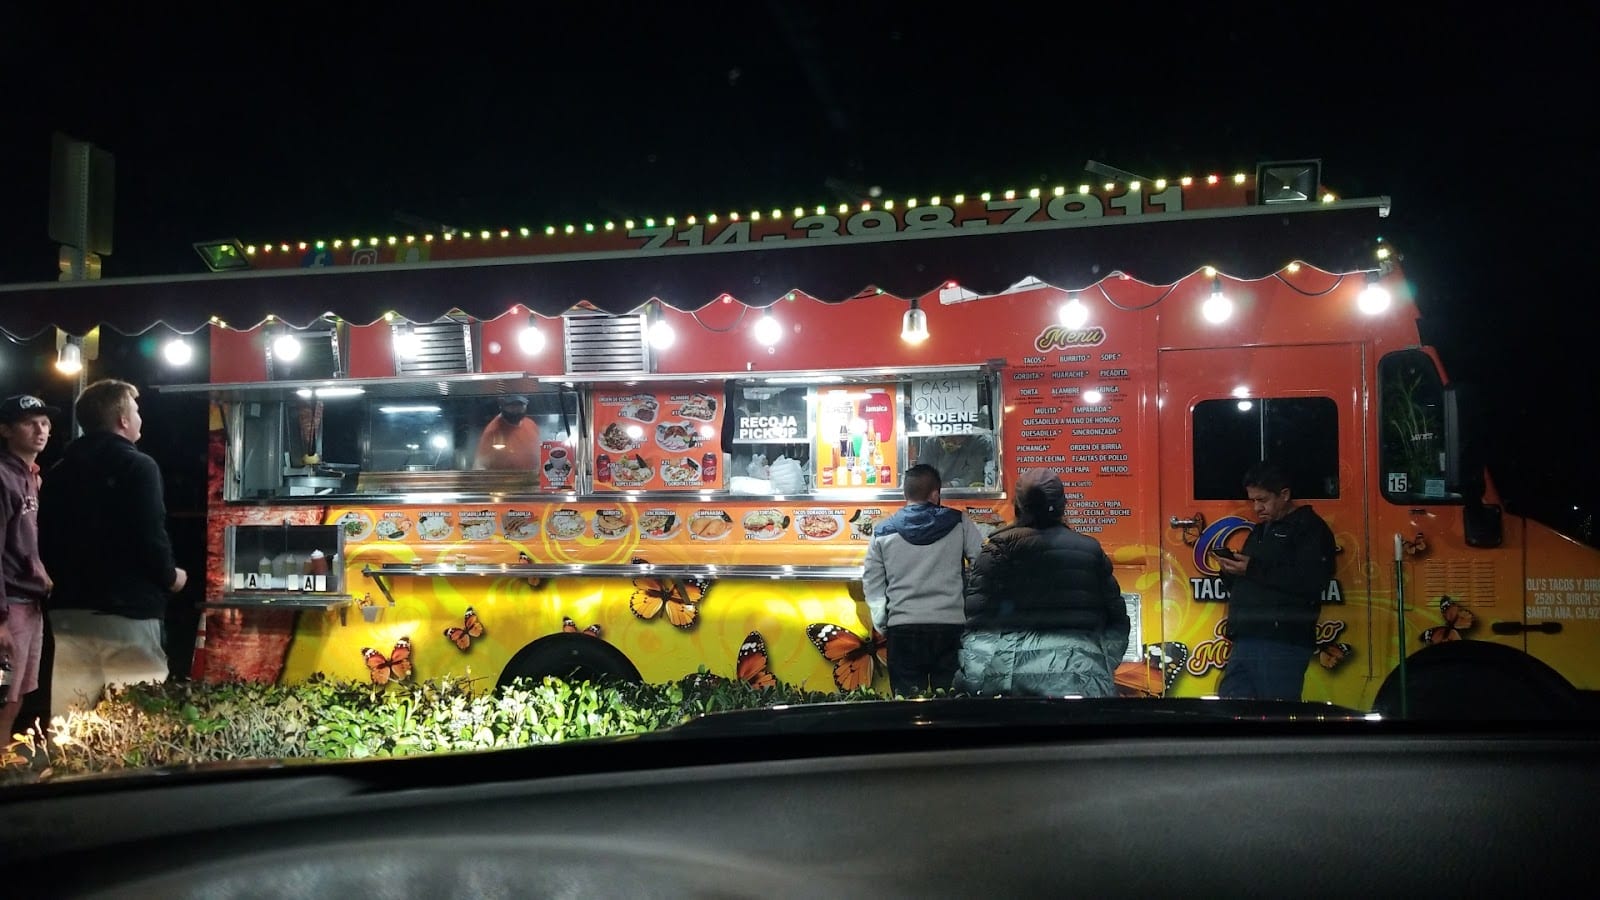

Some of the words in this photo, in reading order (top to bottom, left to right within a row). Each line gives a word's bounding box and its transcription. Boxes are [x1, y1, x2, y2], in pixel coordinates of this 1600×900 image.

[627, 186, 1184, 250] 714-398-7911
[1037, 325, 1103, 351] Menu
[1024, 356, 1042, 365] TACOS
[1059, 354, 1086, 363] BURRITO
[1101, 352, 1117, 361] SOPE
[1013, 372, 1040, 381] GORDITA
[1052, 371, 1084, 379] HUARACHE
[1100, 370, 1128, 378] PICADITA
[921, 380, 961, 395] CASH
[1020, 388, 1038, 396] TORTA
[1051, 386, 1080, 395] ALAMBRE
[1095, 386, 1119, 394] GRINGA
[915, 394, 970, 412] ONLY
[1073, 406, 1107, 414] EMPANADA
[740, 416, 798, 428] RECOJA
[914, 411, 979, 424] ORDENE
[1023, 418, 1059, 426] QUESADILLA
[1066, 417, 1084, 425] MANO
[1086, 417, 1093, 425] DE
[1094, 416, 1120, 424] HONGOS
[740, 428, 773, 440] PICK
[918, 423, 974, 435] RDER
[1021, 430, 1058, 438] QUESADILLA
[1072, 428, 1117, 436] SINCRONIZADA
[1016, 444, 1047, 452] PICHANGA
[1016, 455, 1034, 463] PLATO
[1035, 455, 1044, 463] DE
[1072, 454, 1098, 462] FLAUTAS
[1100, 454, 1108, 462] DE
[1390, 478, 1406, 491] 15
[249, 574, 257, 588] A
[304, 576, 313, 590] A
[1527, 578, 1547, 591] OLI'S
[1548, 578, 1574, 592] TACOS
[1576, 579, 1582, 591] Y
[1191, 578, 1230, 600] TAC
[1534, 592, 1555, 605] 2520
[1566, 592, 1592, 605] BIRCH
[1527, 606, 1552, 618] SANTA
[1576, 606, 1586, 619] CA
